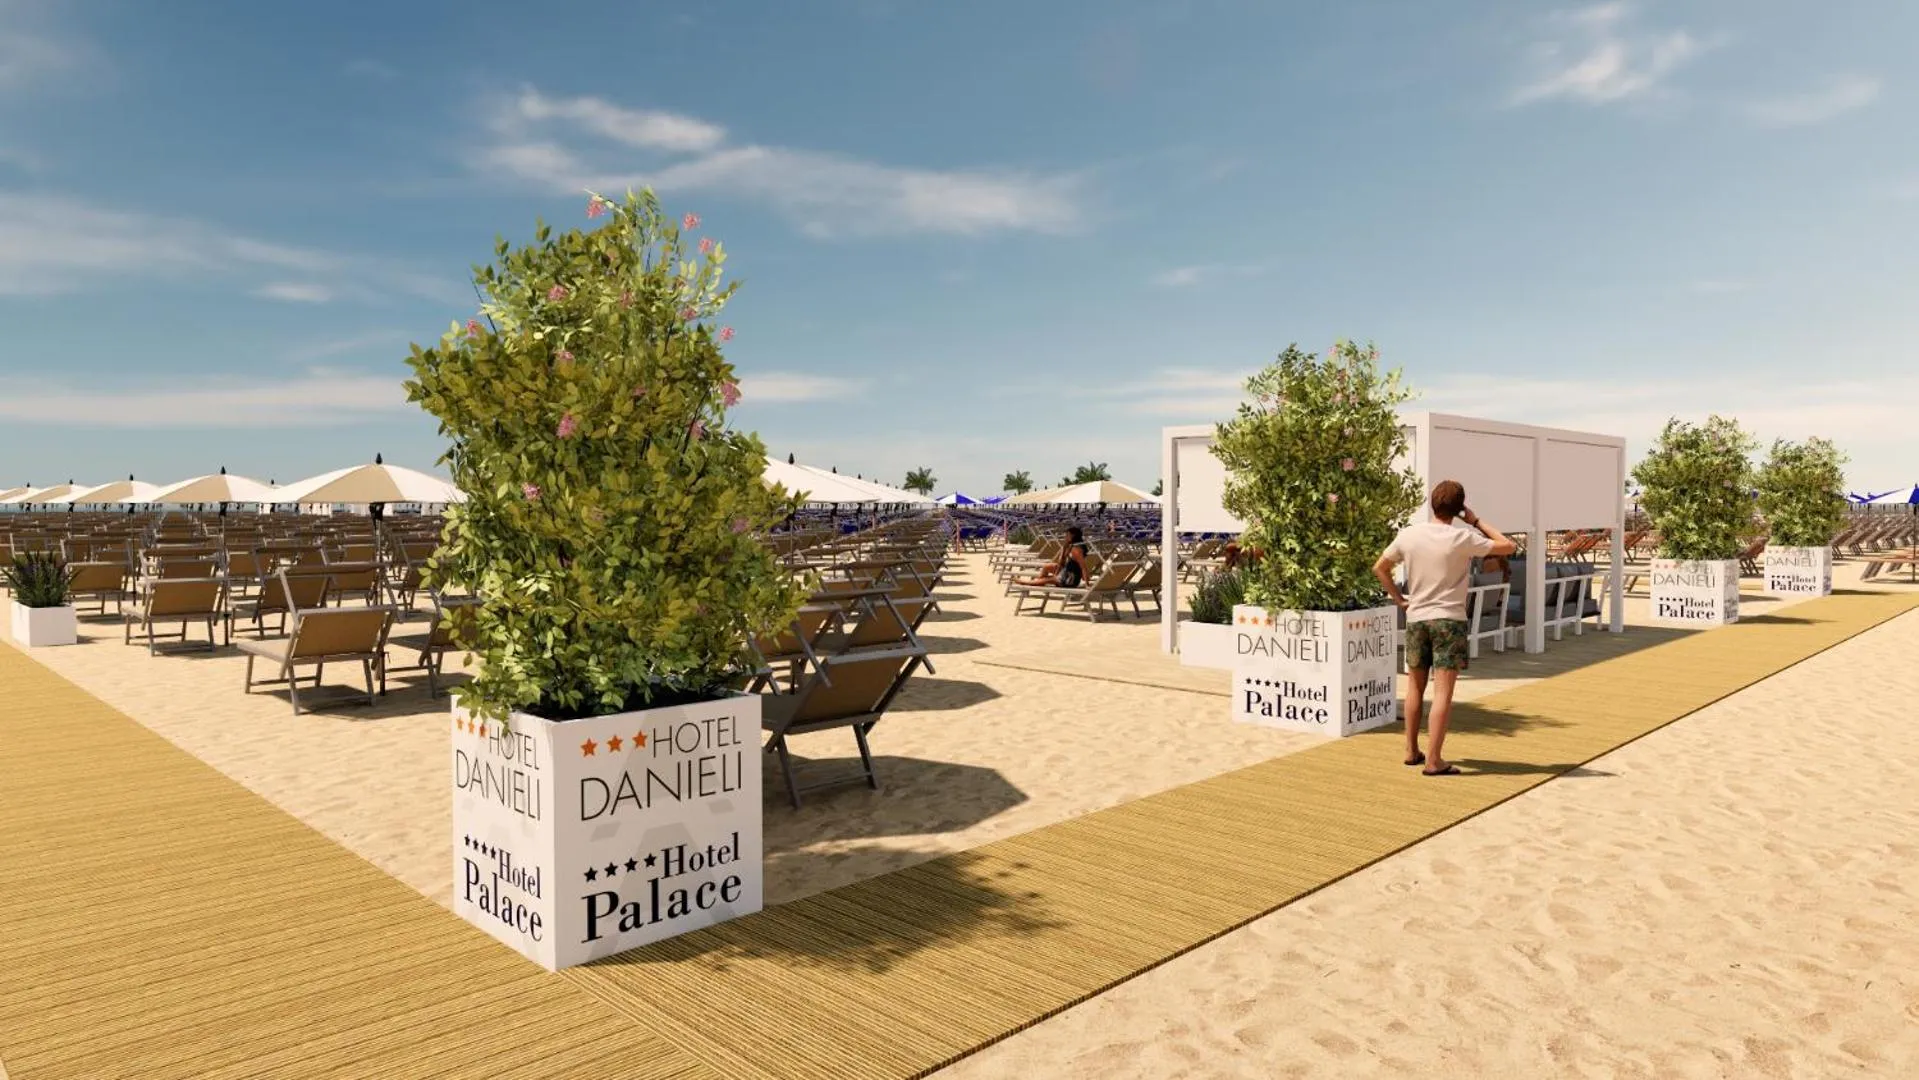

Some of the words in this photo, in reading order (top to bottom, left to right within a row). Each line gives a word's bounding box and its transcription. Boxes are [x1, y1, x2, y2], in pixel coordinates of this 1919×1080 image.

[1654, 573, 1715, 588] DANIELI
[1772, 580, 1816, 591] Palace
[1659, 604, 1715, 619] Palace
[1685, 597, 1714, 608] Hotel
[1275, 616, 1328, 638] HOTEL
[1367, 615, 1393, 634] HOTEL
[1238, 633, 1329, 662] DANIELI
[1348, 634, 1393, 663] DANIELI
[1283, 681, 1327, 702] Hotel
[1369, 676, 1391, 697] Hotel
[1244, 689, 1328, 724] Palace
[1347, 696, 1392, 724] Palace
[489, 724, 540, 770] HOTEL
[653, 716, 742, 758] HOTEL
[456, 749, 541, 821] DANIELI
[581, 752, 742, 821] DANIELI
[661, 832, 741, 879] Hotel
[499, 848, 541, 899] Hotel
[463, 857, 543, 942] Palace
[581, 873, 743, 944] Palace
